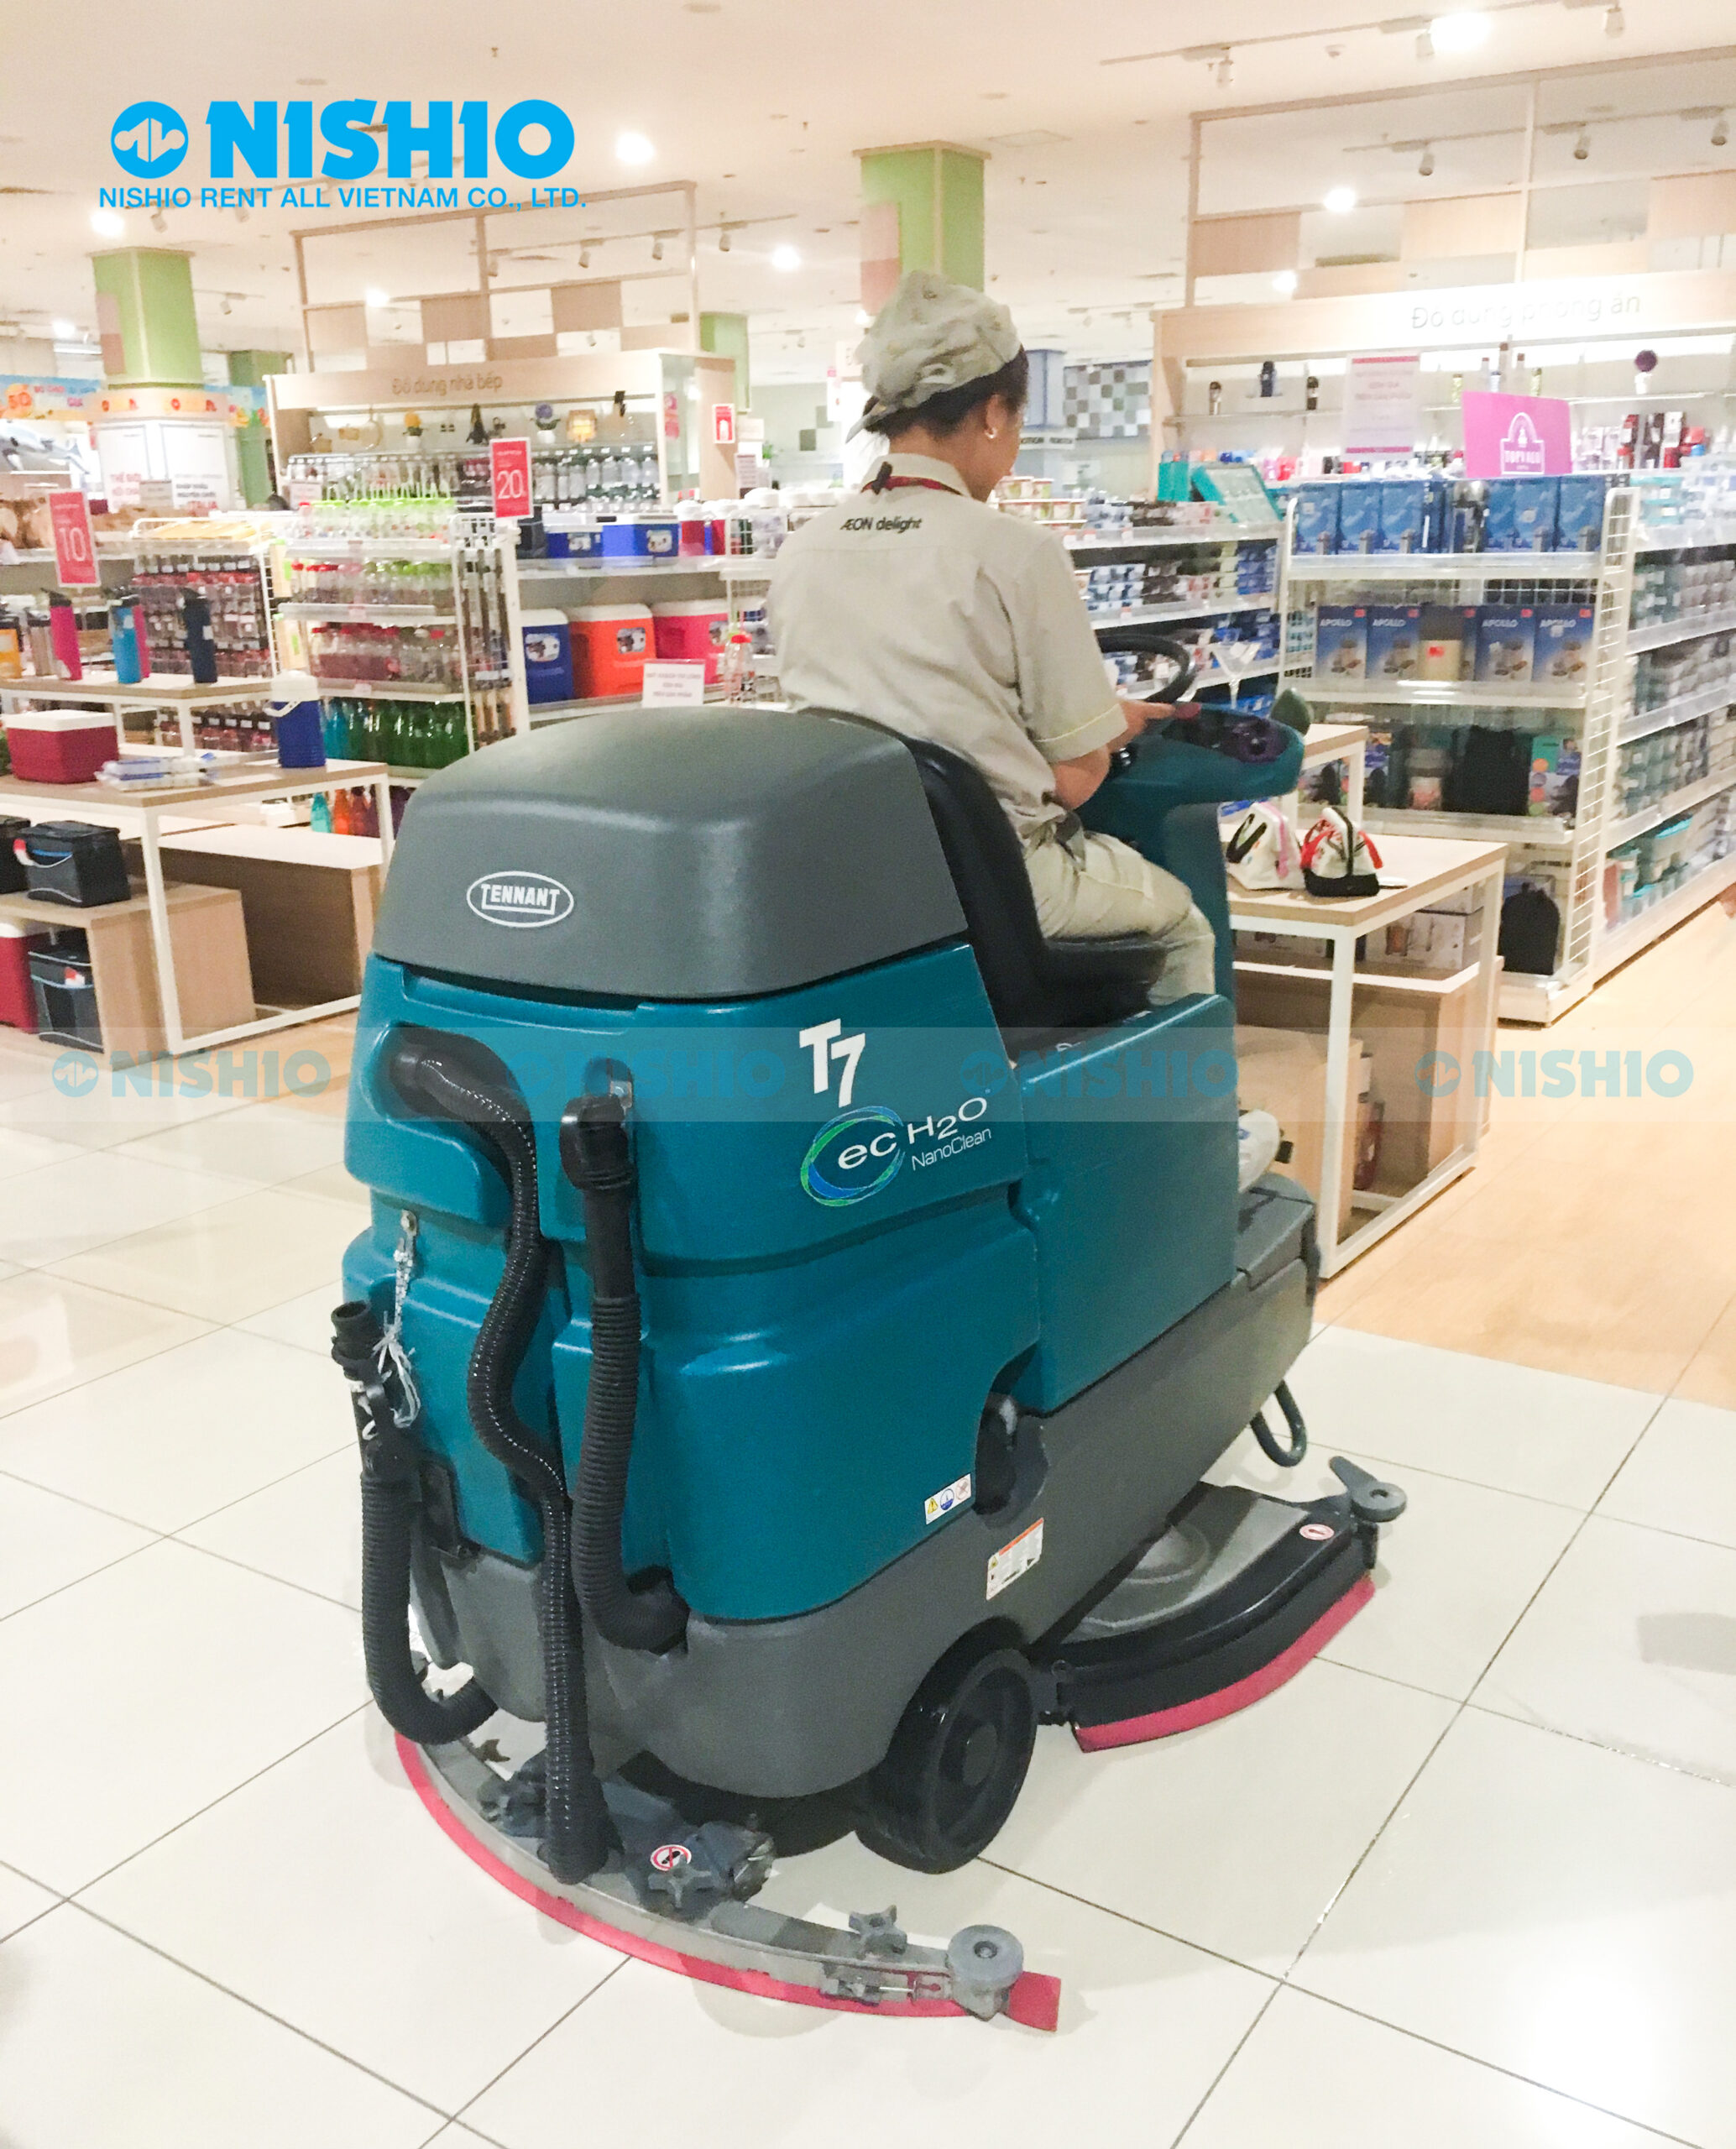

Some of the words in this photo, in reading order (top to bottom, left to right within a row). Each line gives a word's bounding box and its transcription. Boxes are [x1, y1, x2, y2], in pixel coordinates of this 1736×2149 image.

[876, 515, 923, 534] delight
[58, 526, 86, 562] 10
[1320, 618, 1353, 627] APOLLO
[480, 883, 561, 915] TENNANT
[799, 1018, 865, 1108] T7
[912, 1128, 992, 1171] NanoClean
